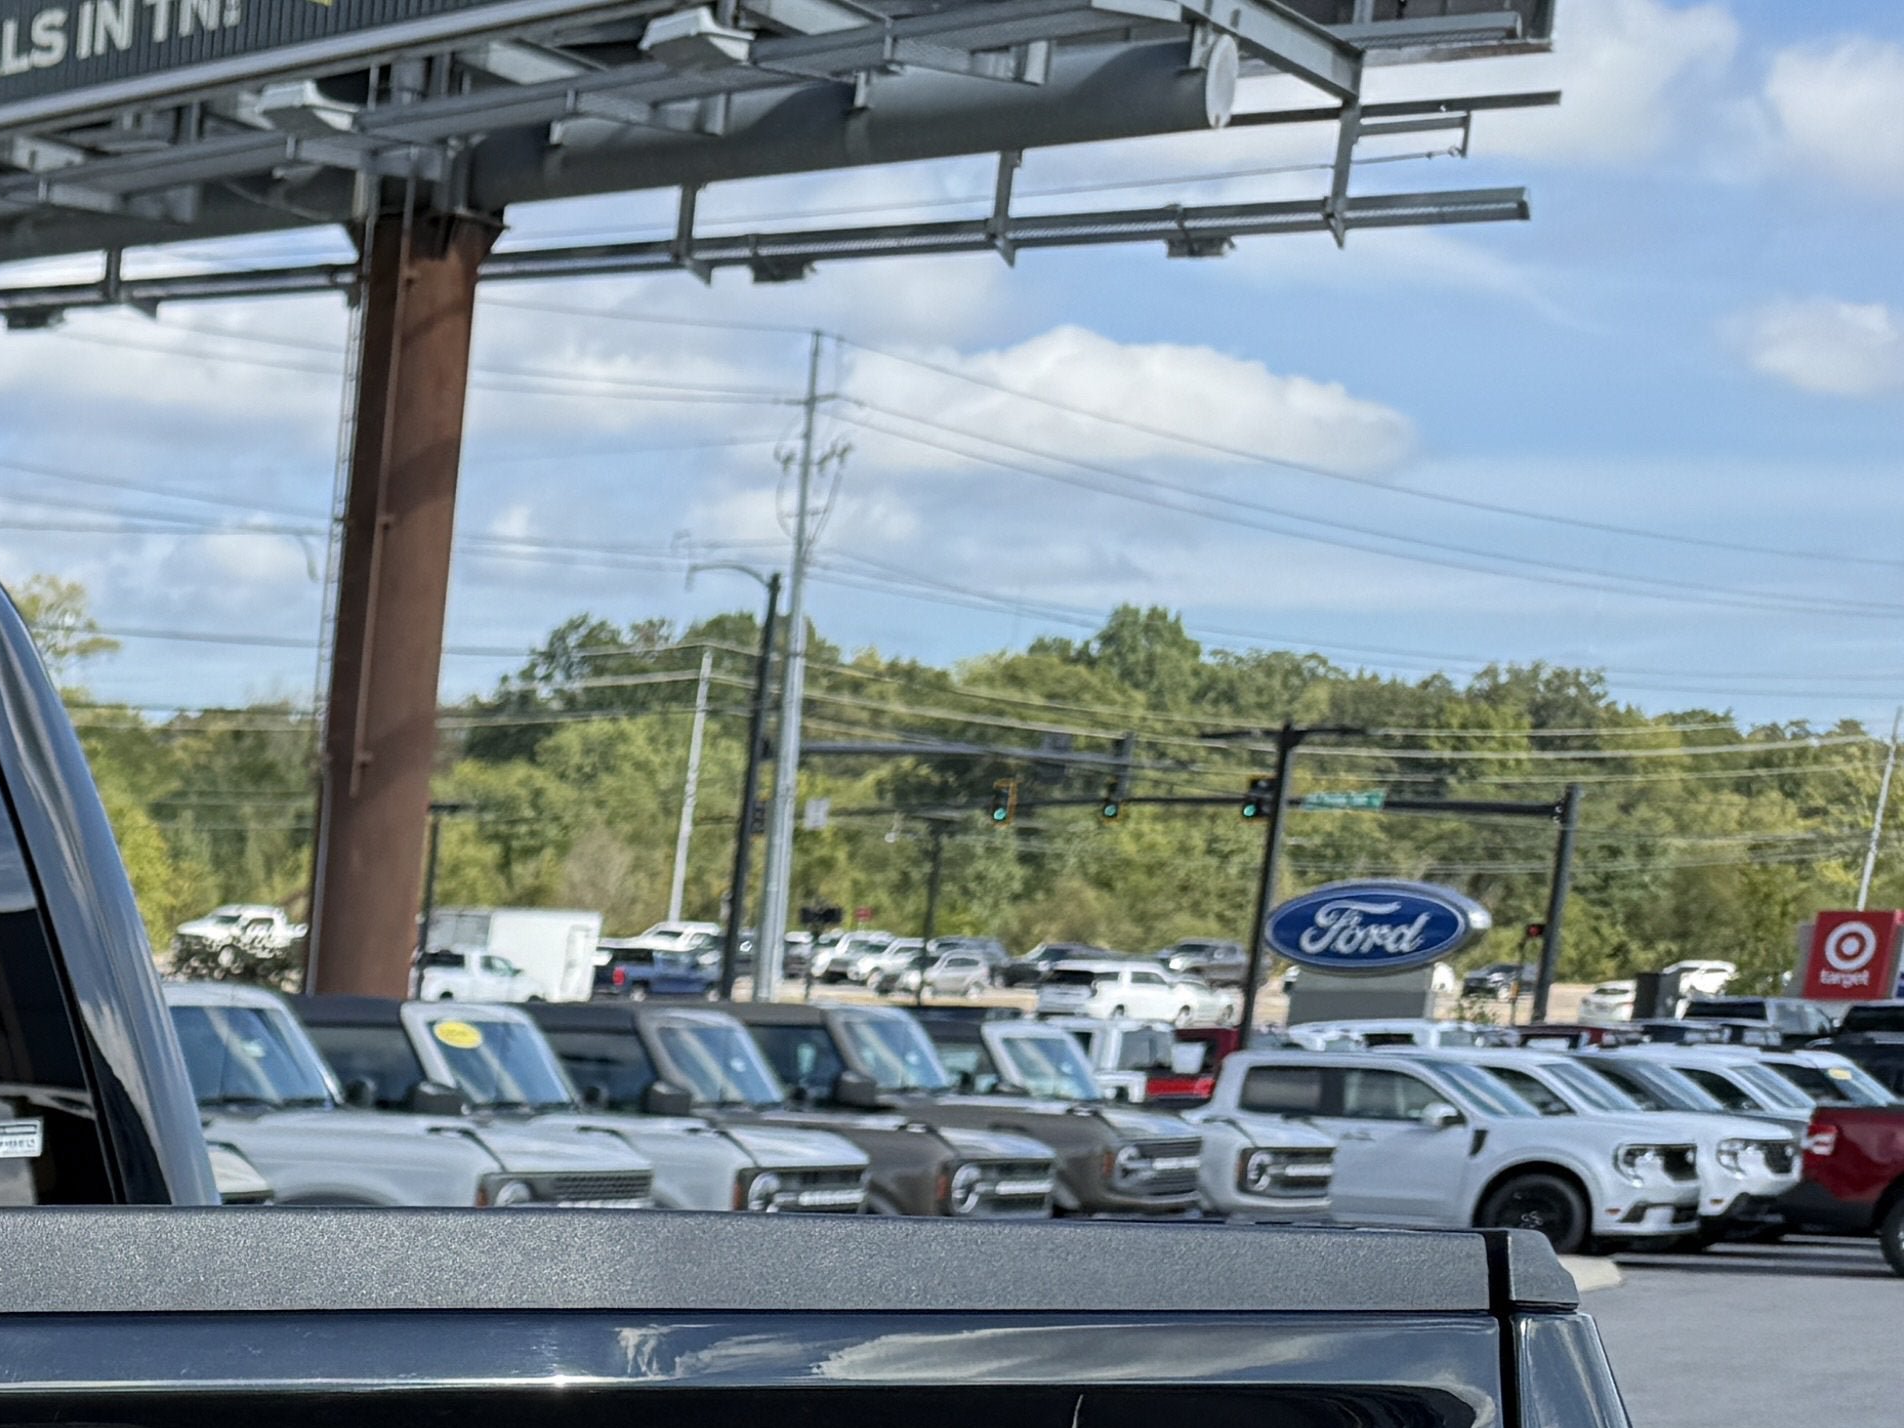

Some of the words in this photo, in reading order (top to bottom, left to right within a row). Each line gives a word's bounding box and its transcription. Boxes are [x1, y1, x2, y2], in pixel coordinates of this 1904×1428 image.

[76, 0, 135, 60] IN
[1299, 899, 1431, 954] Ford
[1819, 968, 1870, 989] target
